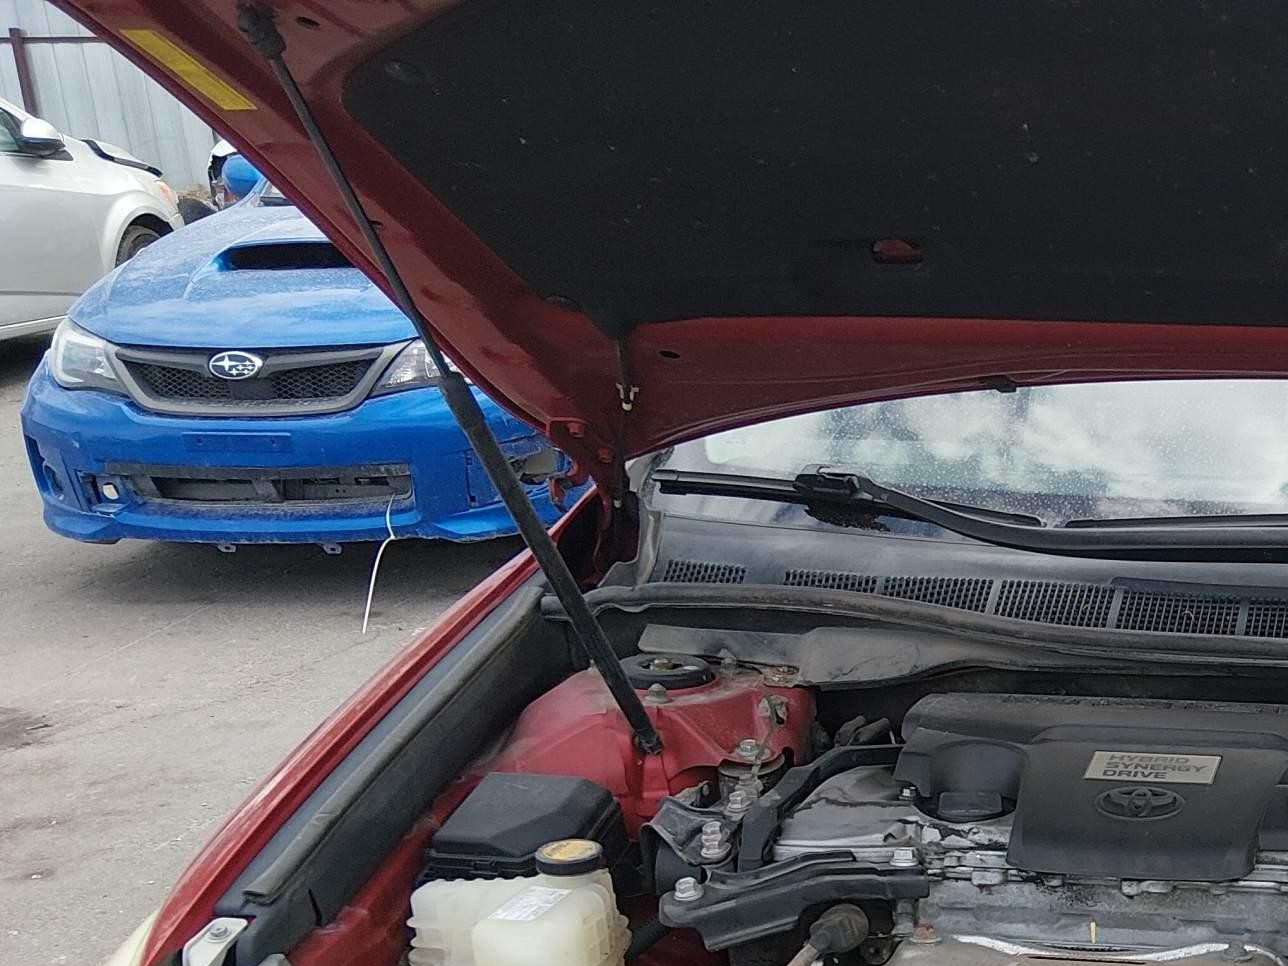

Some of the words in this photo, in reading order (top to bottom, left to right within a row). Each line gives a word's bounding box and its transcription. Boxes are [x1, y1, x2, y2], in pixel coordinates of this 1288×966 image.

[1108, 754, 1190, 764] HYBRID
[1105, 761, 1208, 773] SYNERGY
[1102, 769, 1168, 779] DRIVE
